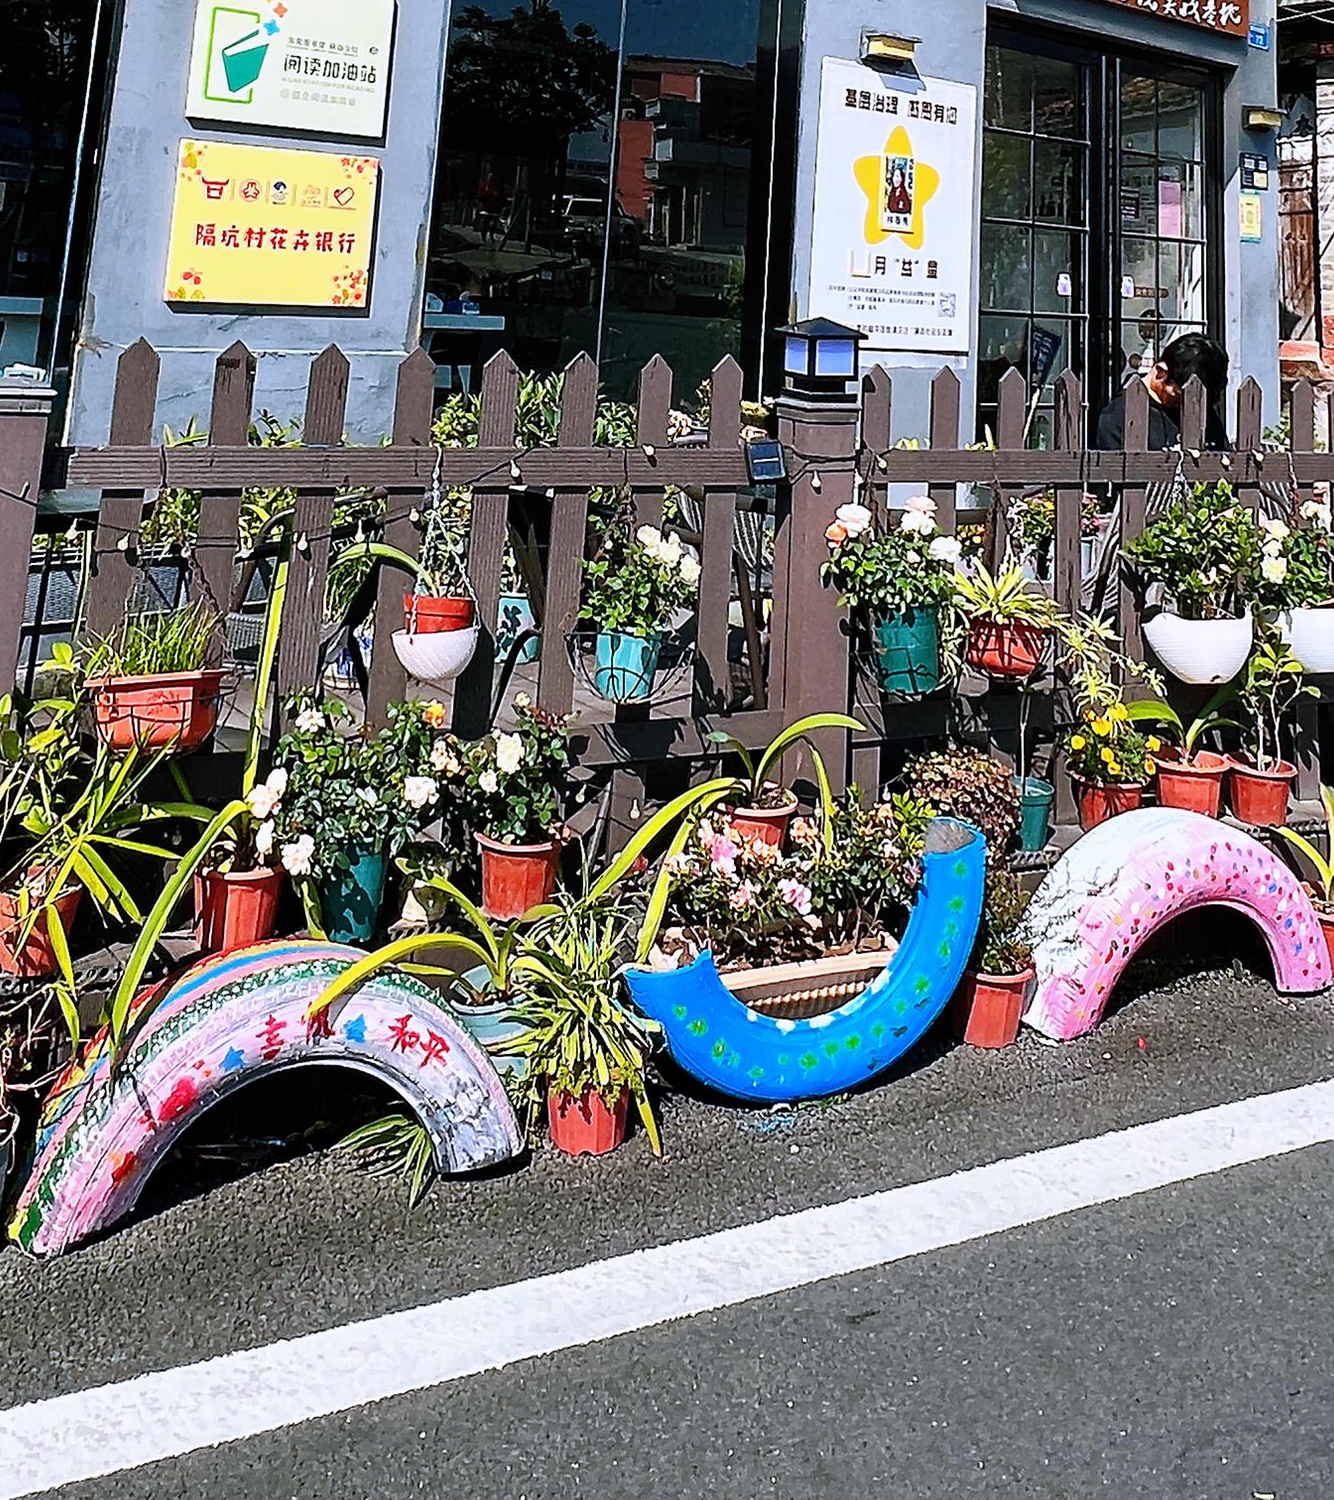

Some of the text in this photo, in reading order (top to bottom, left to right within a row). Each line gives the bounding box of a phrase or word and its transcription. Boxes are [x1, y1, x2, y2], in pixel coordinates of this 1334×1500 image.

[284, 53, 377, 84] 阅读加油站
[195, 223, 356, 254] 隔坑村花卉银行
